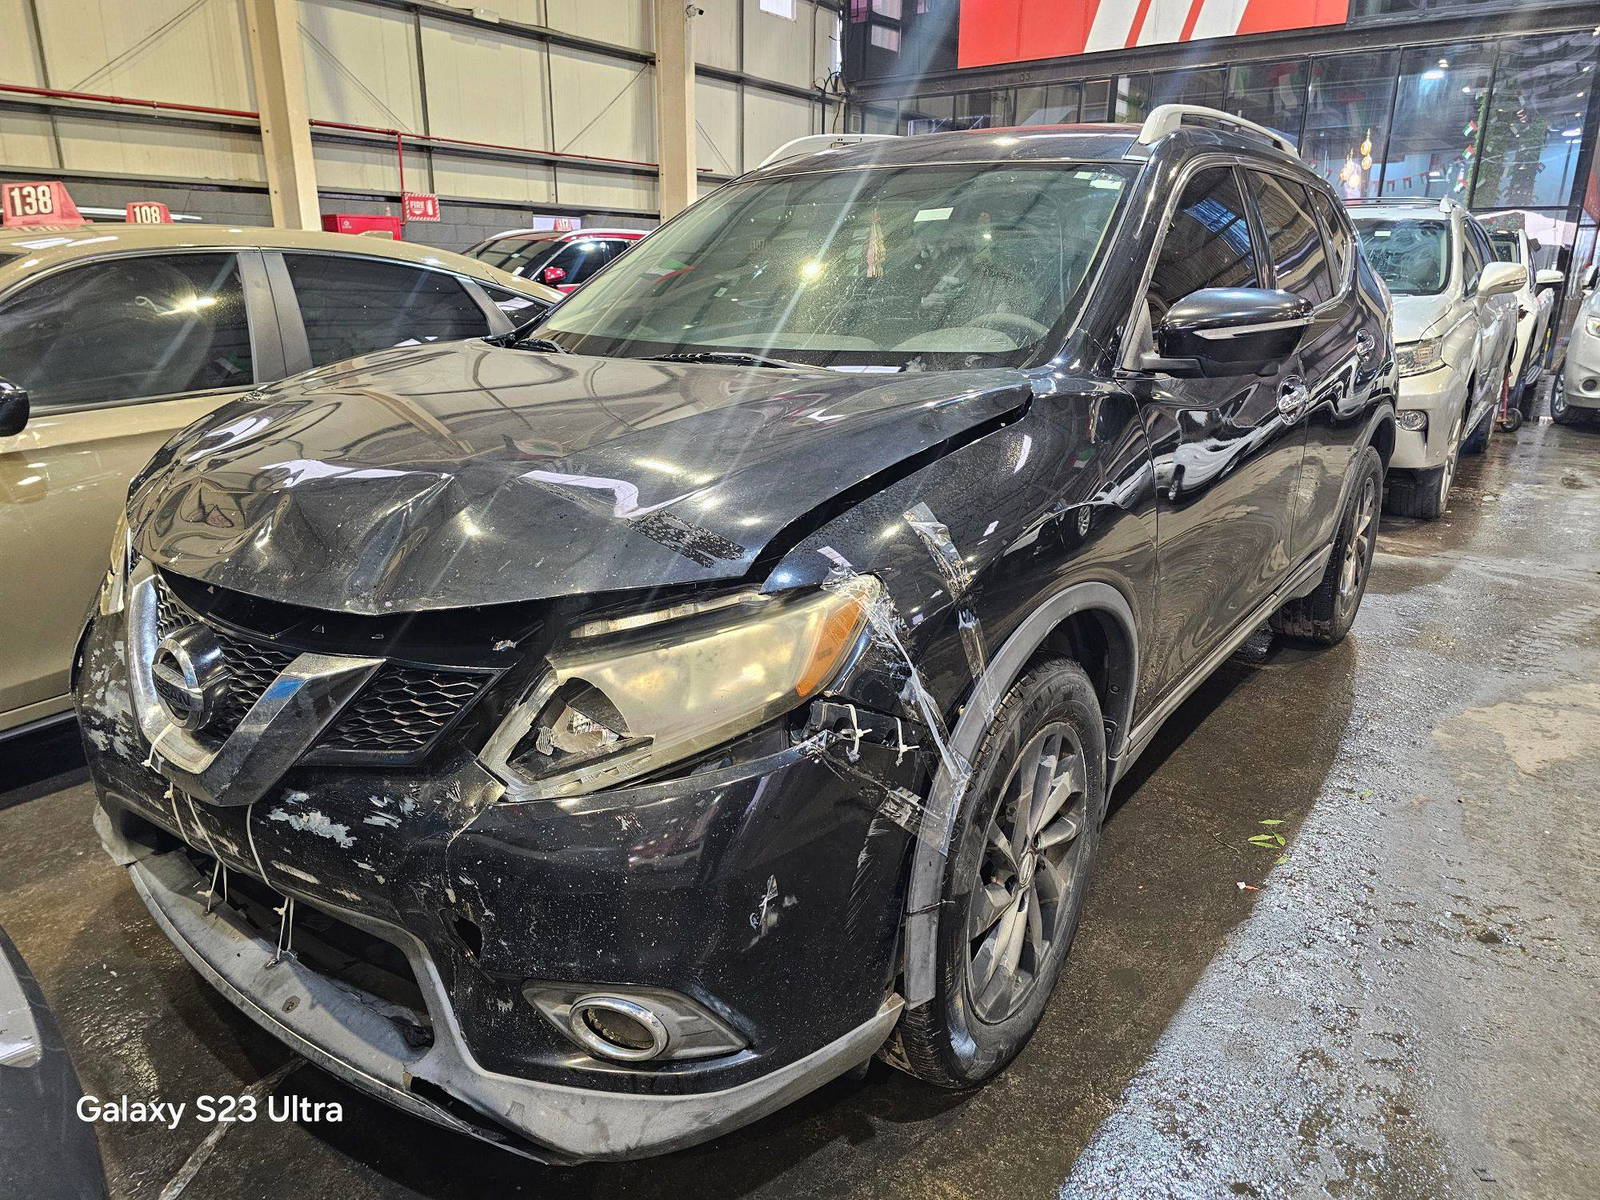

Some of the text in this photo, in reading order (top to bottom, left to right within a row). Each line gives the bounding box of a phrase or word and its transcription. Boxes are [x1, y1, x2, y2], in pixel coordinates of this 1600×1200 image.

[10, 185, 53, 216] 138
[410, 200, 425, 209] FIRE
[134, 206, 161, 224] 108
